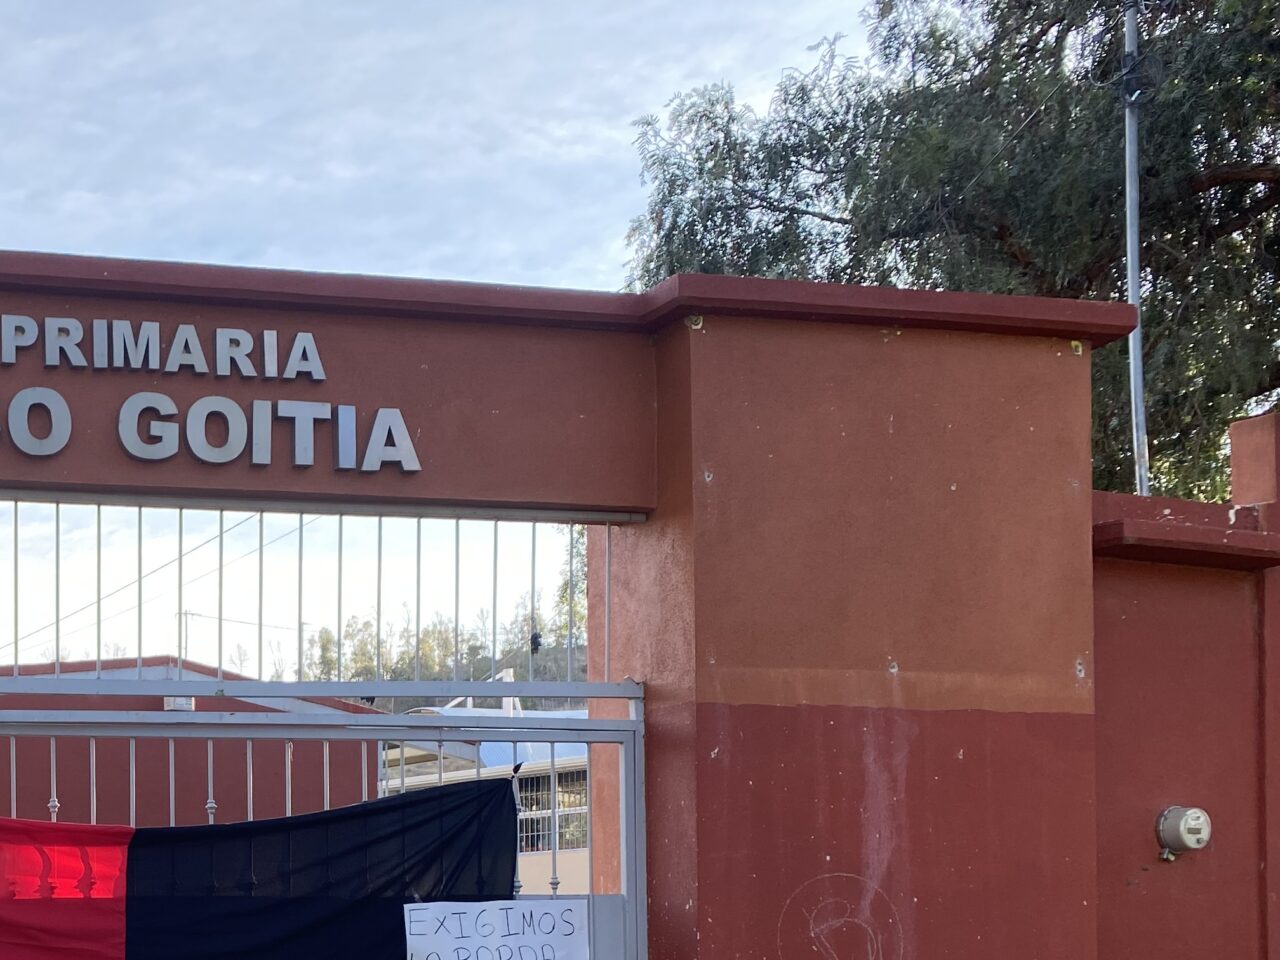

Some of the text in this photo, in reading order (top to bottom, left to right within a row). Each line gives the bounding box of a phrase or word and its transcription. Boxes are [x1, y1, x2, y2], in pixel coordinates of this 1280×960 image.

[0, 313, 327, 382] PRIMARIA
[118, 391, 423, 473] GOITIA
[408, 906, 576, 940] EXIGIMOS
